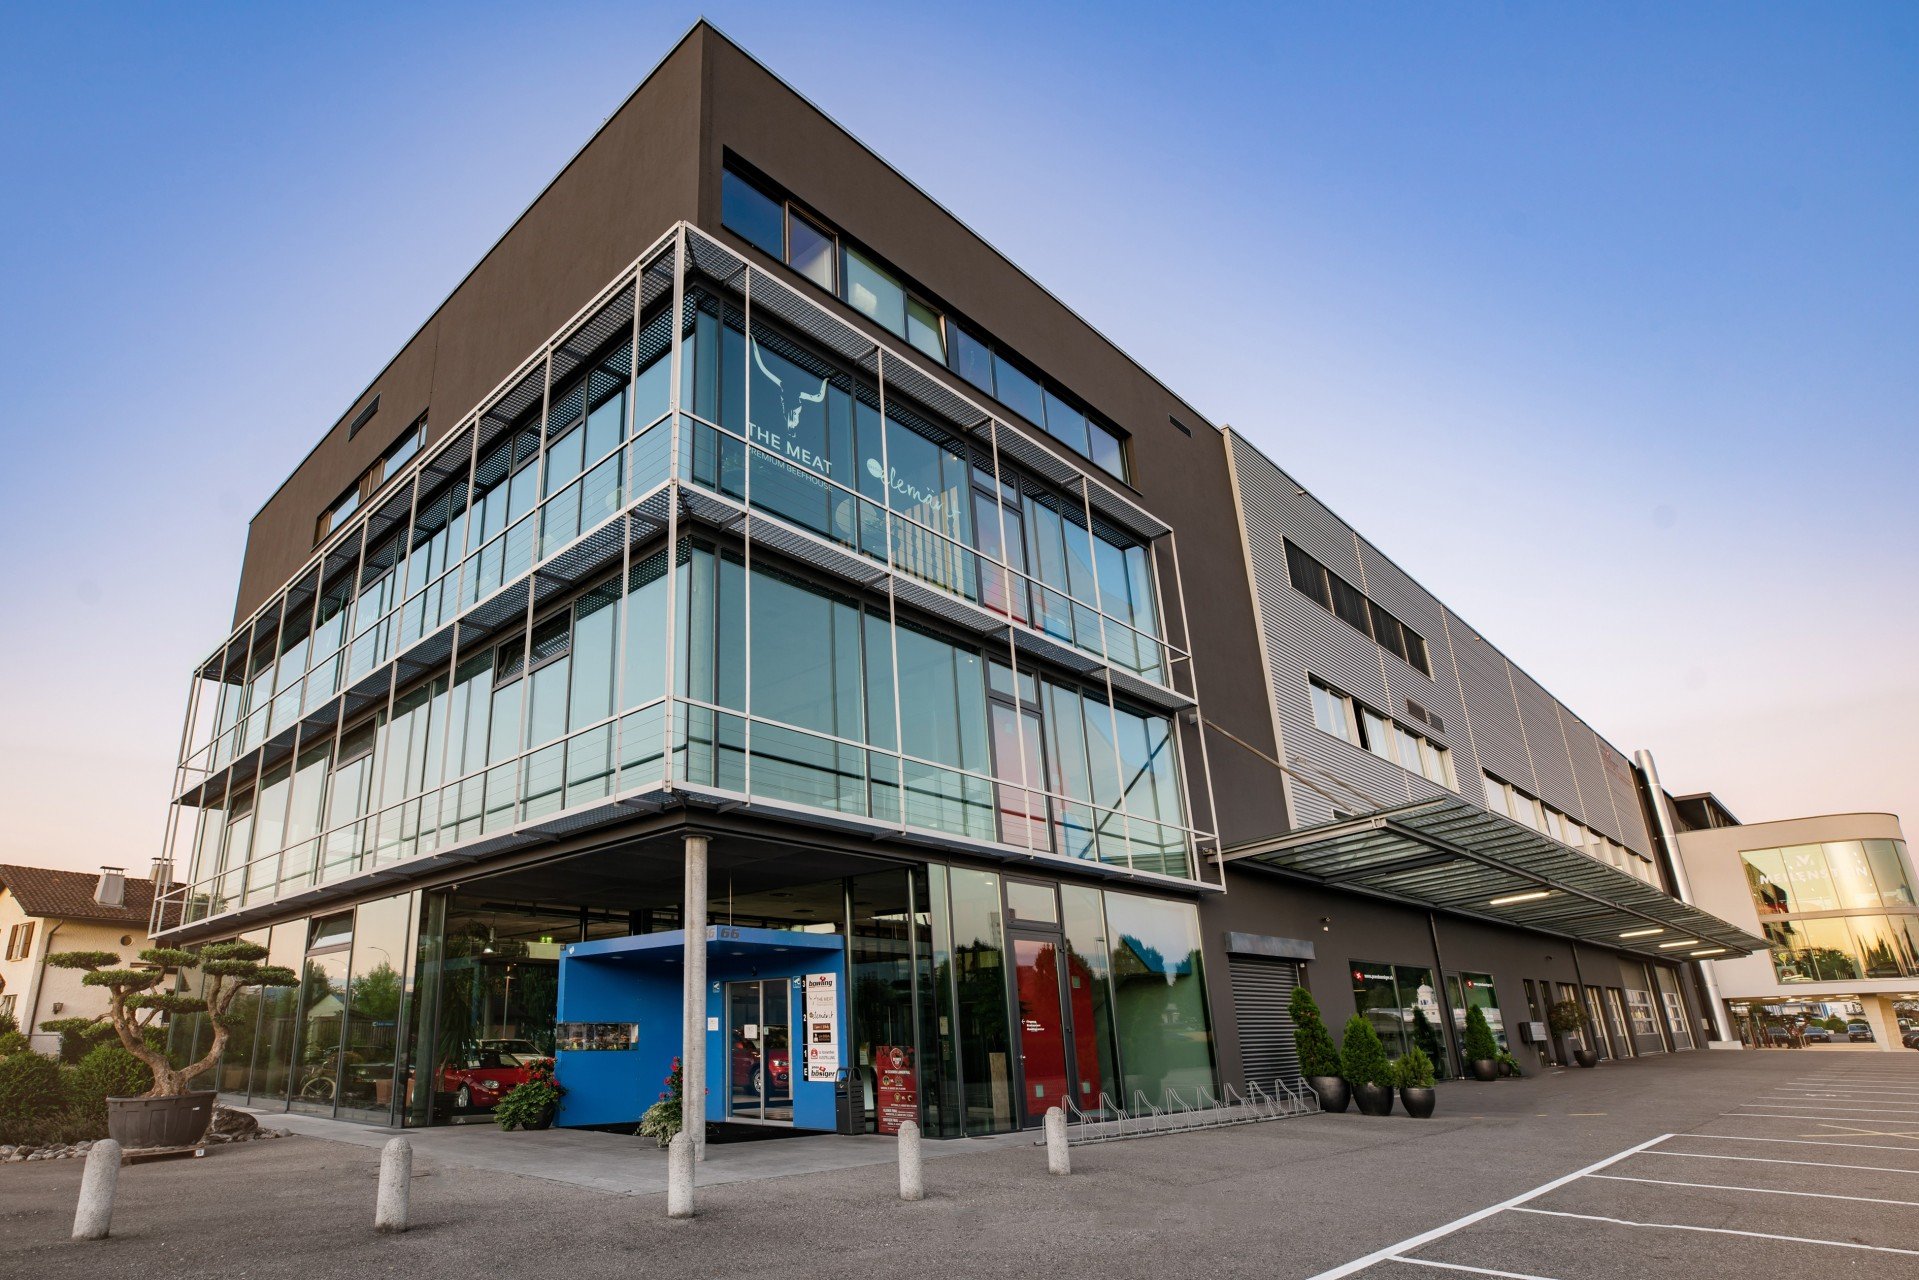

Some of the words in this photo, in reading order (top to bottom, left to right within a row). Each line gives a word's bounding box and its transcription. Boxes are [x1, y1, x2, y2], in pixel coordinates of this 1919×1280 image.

[748, 422, 781, 450] THE
[786, 441, 833, 474] MEAT
[721, 928, 739, 938] 66
[802, 980, 806, 988] 3
[803, 1014, 806, 1022] 2
[804, 1068, 807, 1076] E
[811, 1069, 835, 1078] bösiger
